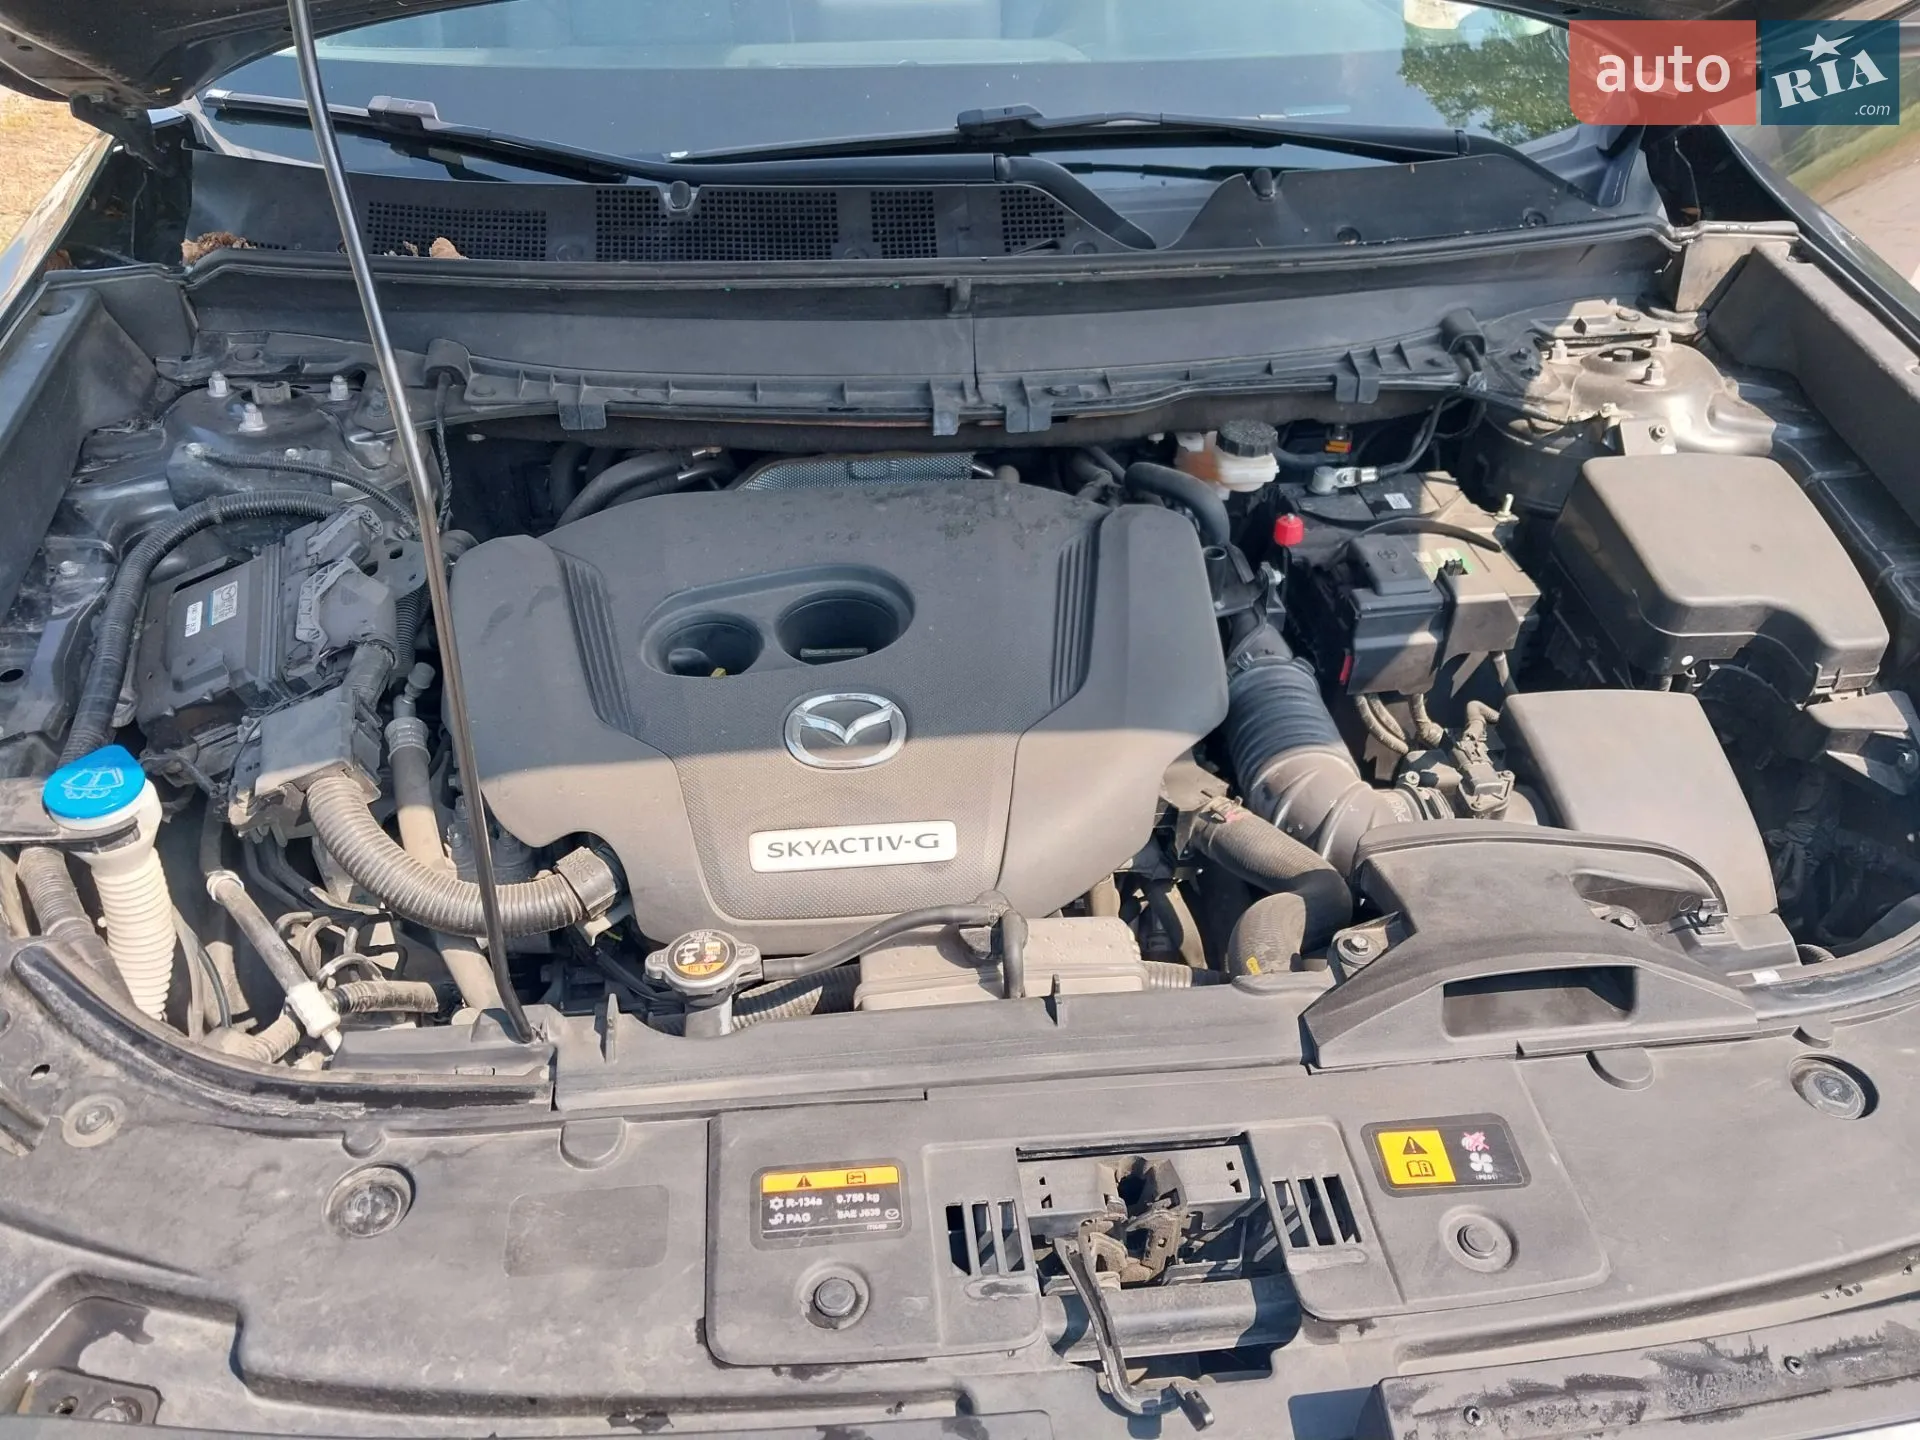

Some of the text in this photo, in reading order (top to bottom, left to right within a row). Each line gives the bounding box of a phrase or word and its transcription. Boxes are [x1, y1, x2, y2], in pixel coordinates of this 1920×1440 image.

[767, 833, 939, 858] SKYACTIV-G
[785, 1196, 823, 1208] R-134a
[866, 1192, 880, 1203] kg
[785, 1212, 812, 1224] PAG
